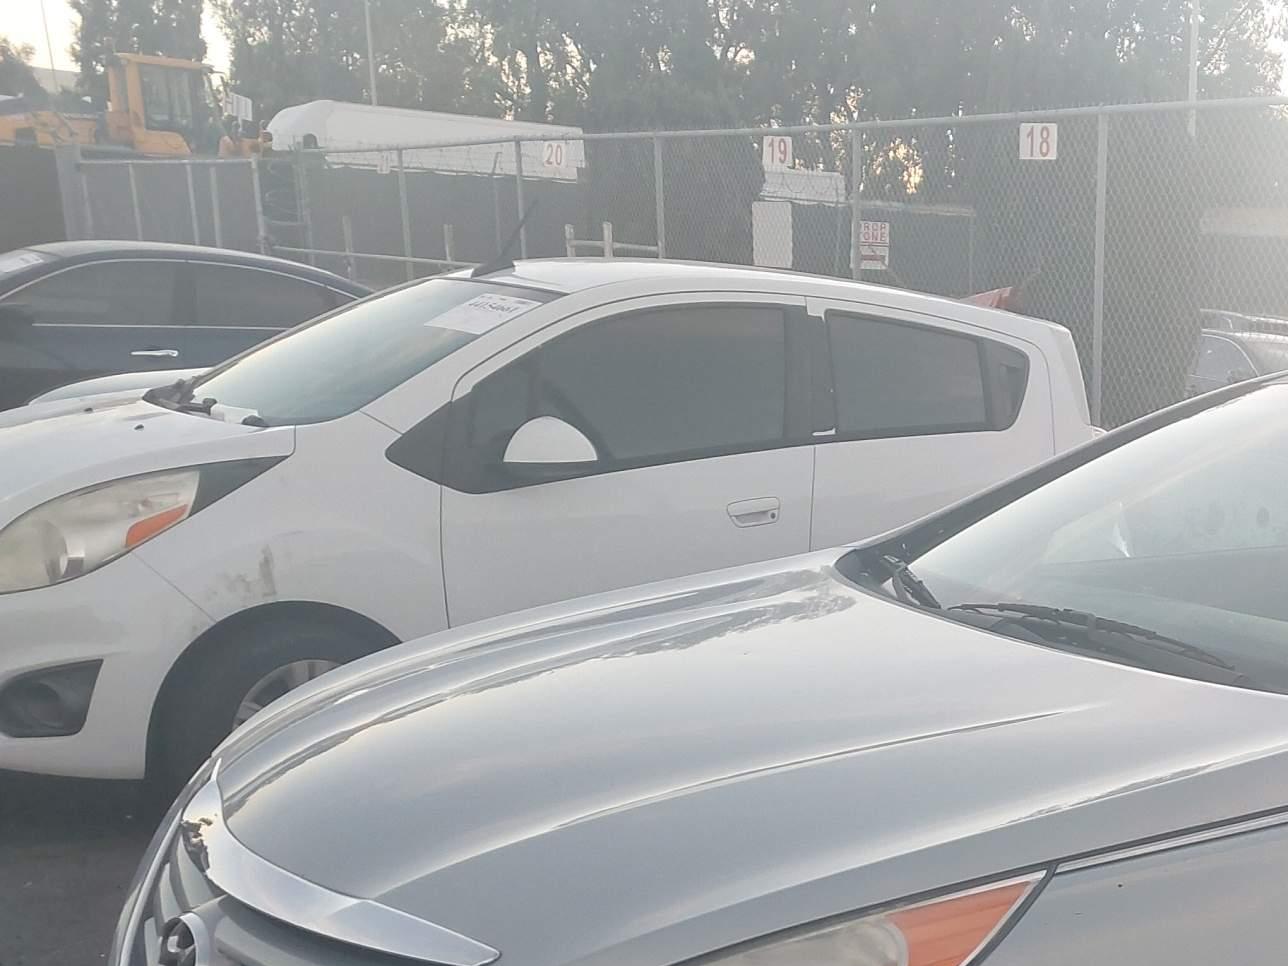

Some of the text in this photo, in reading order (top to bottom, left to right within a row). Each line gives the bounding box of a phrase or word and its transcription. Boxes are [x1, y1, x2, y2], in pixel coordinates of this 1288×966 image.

[544, 143, 563, 166] 20
[768, 137, 788, 164] 19
[1026, 125, 1050, 158] 18
